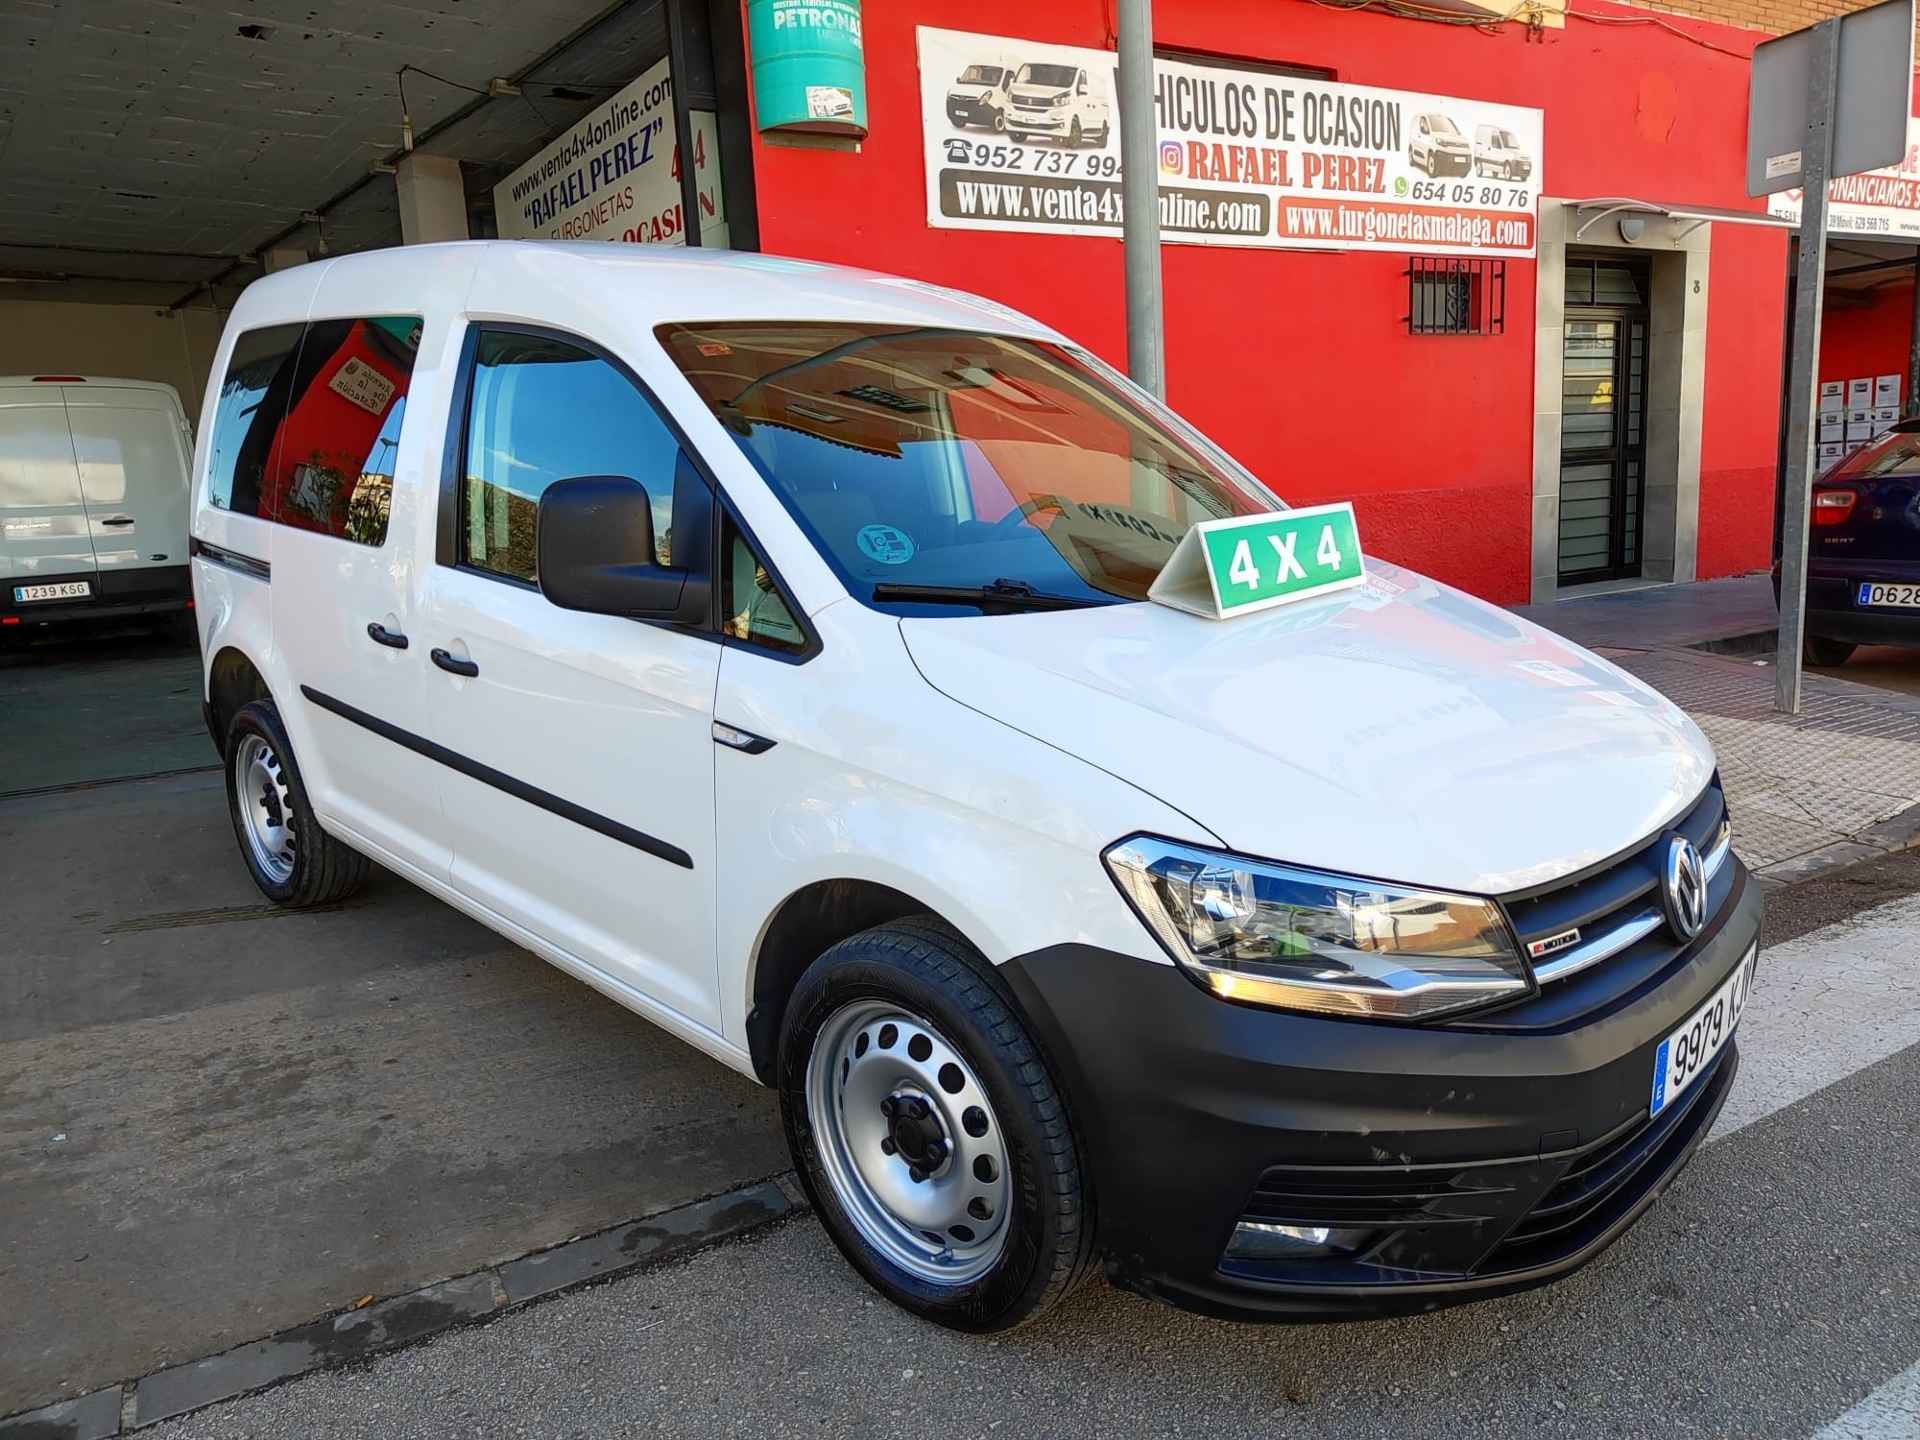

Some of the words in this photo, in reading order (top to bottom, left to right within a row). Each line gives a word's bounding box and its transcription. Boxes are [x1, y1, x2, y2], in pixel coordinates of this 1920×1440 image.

[1265, 87, 1296, 142] DE
[1303, 92, 1401, 152] OCASION
[974, 144, 1024, 170] 952
[1033, 149, 1078, 175] 737
[1187, 141, 1293, 187] RAFAEL
[1302, 151, 1386, 194] PEREZ
[1411, 181, 1446, 202] 654
[1452, 184, 1474, 204] 05
[1480, 186, 1502, 206] 80
[1508, 188, 1529, 208] 76
[1285, 205, 1528, 247] www.furgonetasmalaga.com
[1229, 539, 1260, 590] 4
[1267, 531, 1308, 585] X
[1316, 525, 1342, 572] 4
[25, 585, 57, 599] 1239
[59, 583, 85, 597] KSG
[1872, 586, 1920, 605] 0628
[1674, 997, 1724, 1087] 9979
